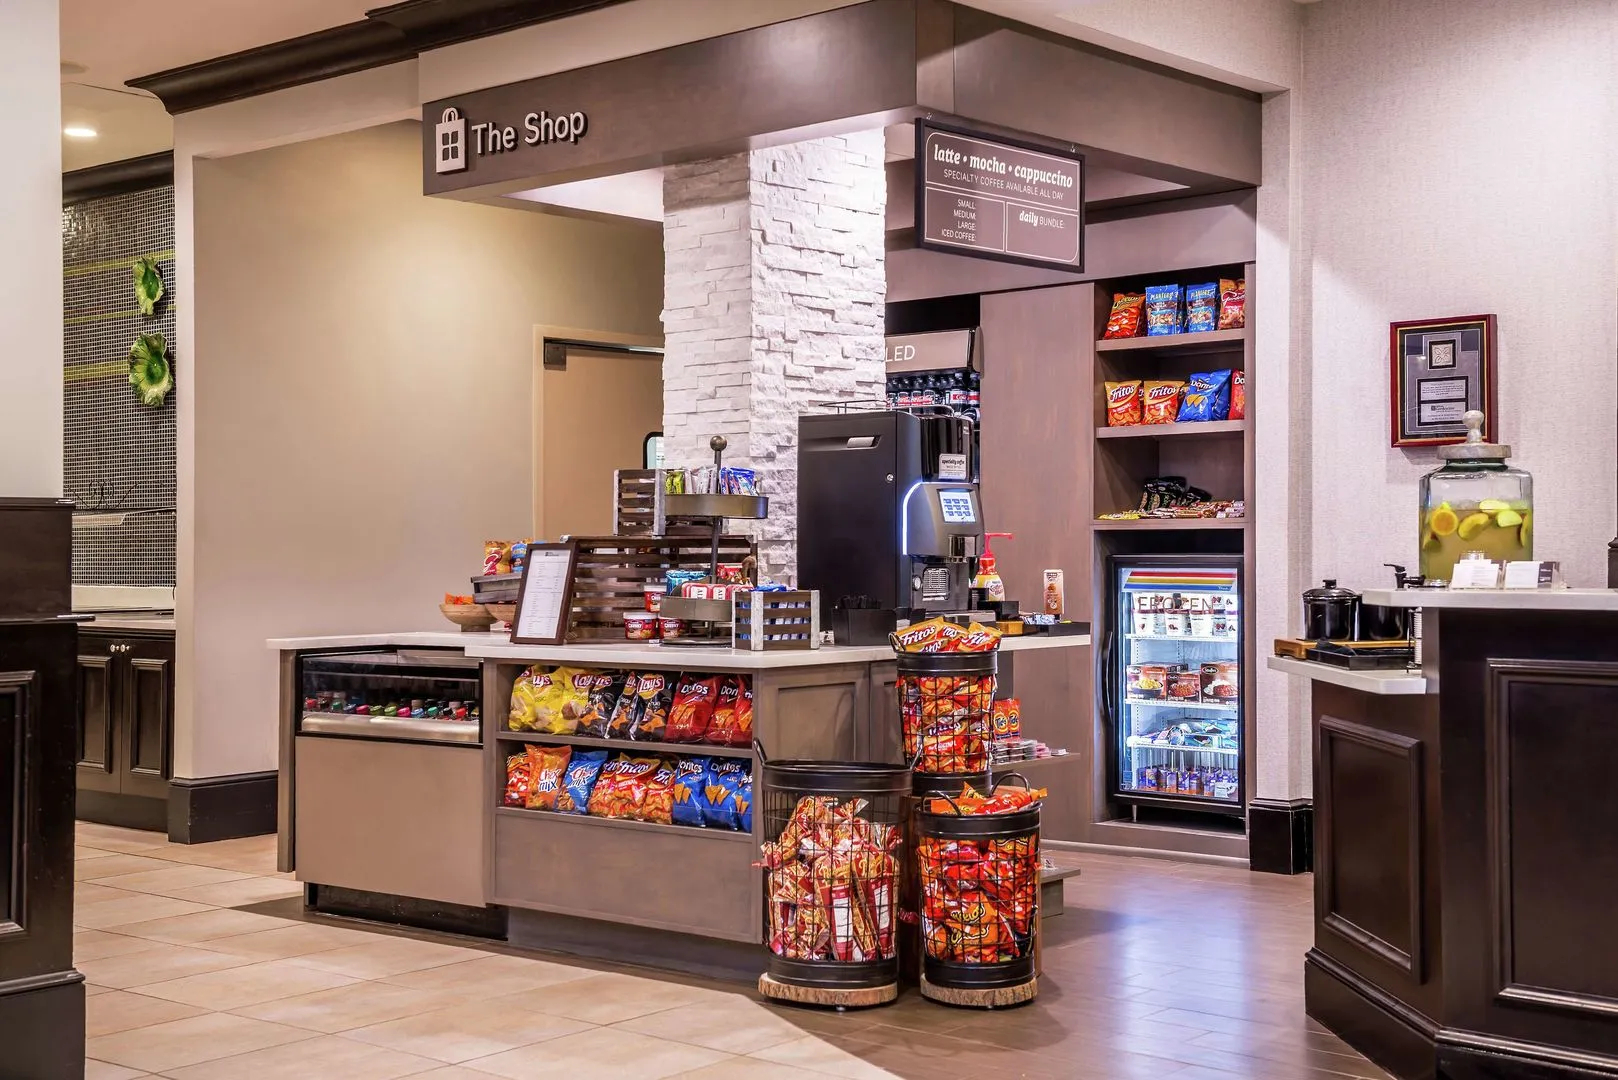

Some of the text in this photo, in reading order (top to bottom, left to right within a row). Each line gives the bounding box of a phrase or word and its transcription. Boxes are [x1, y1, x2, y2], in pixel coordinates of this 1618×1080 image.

[472, 110, 586, 154] The Shop
[934, 144, 1073, 188] latte mocha cappuccino
[944, 168, 1064, 201] SPECIALTY COFFEE AVAILABLE ALL DAY
[1019, 210, 1039, 227] daily
[941, 228, 954, 238] ICED
[1110, 385, 1136, 402] Fritos
[1149, 385, 1177, 400] Fritos
[1138, 597, 1214, 614] FROZEN
[899, 625, 936, 646] Fritos
[710, 762, 741, 774] Doritos
